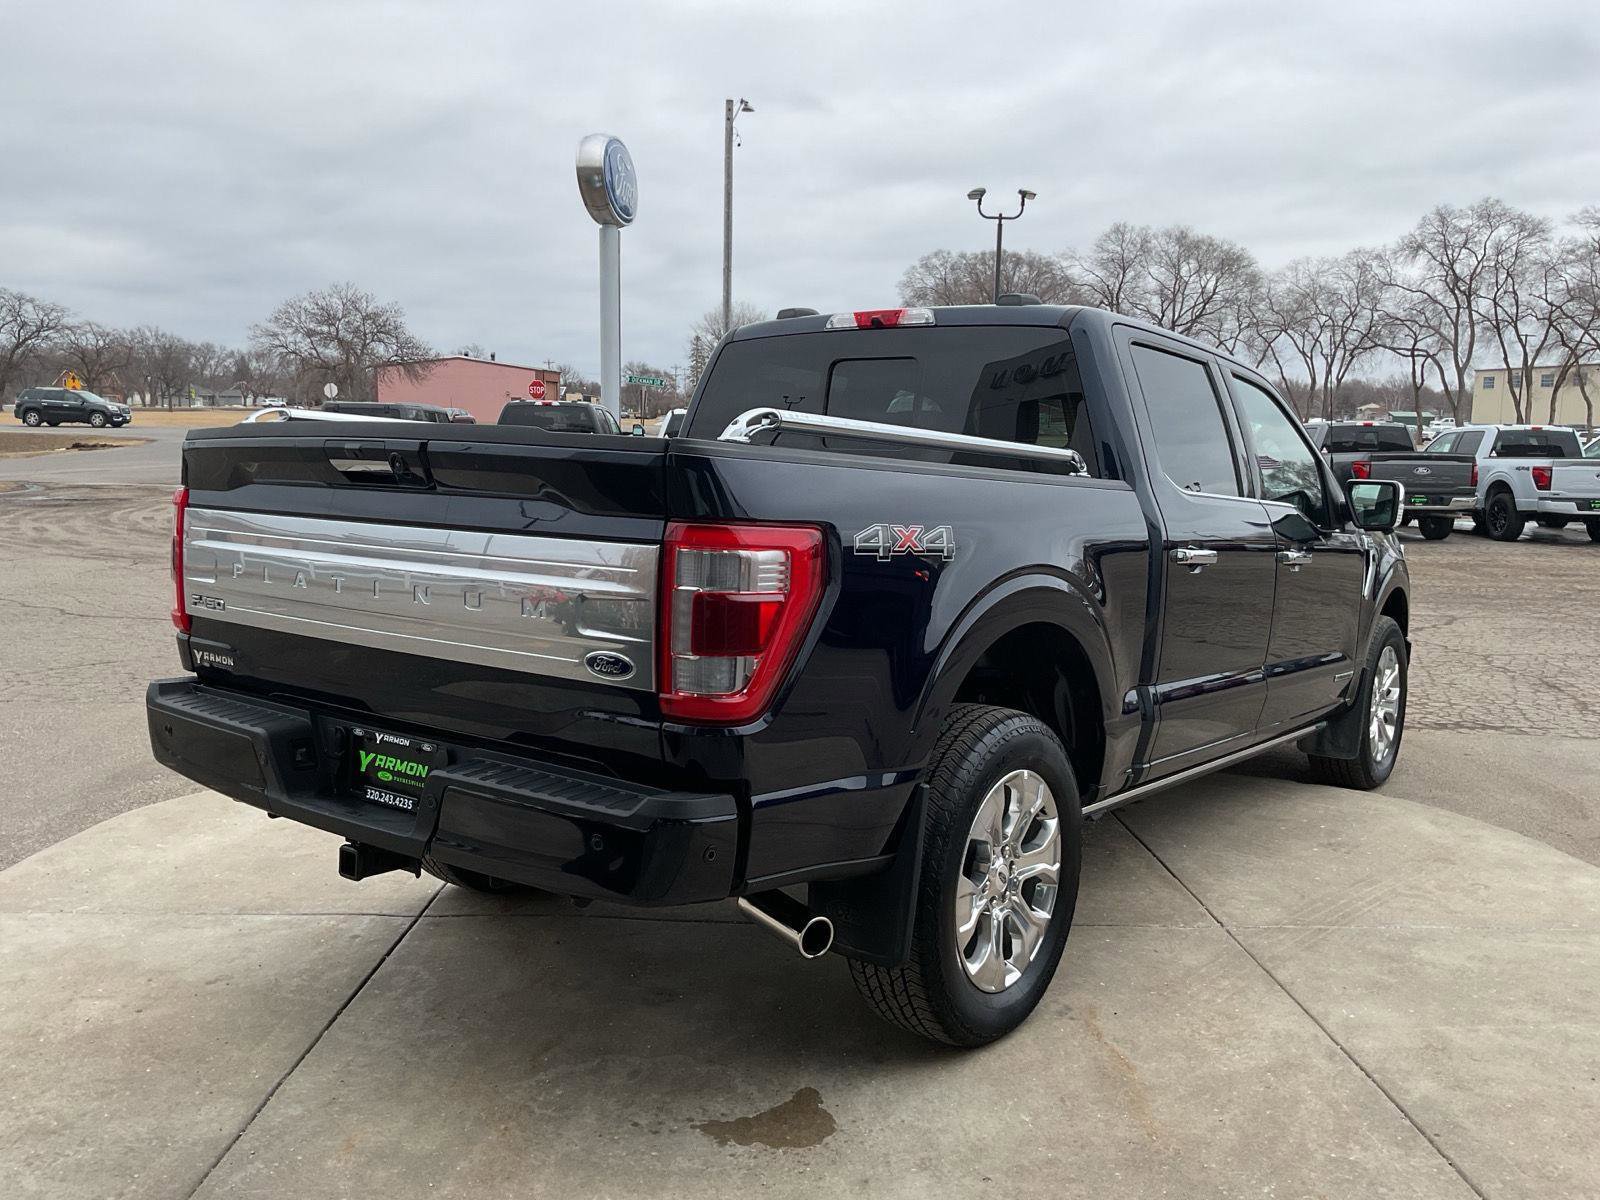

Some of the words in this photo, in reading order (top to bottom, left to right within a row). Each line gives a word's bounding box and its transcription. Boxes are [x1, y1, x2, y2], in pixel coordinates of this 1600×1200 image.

[232, 562, 547, 619] PLATINUM
[193, 649, 234, 666] YARMON
[594, 656, 622, 673] Ford
[375, 732, 410, 746] YARMON
[359, 750, 428, 778] YARMON
[366, 789, 413, 810] 320.243.4235
